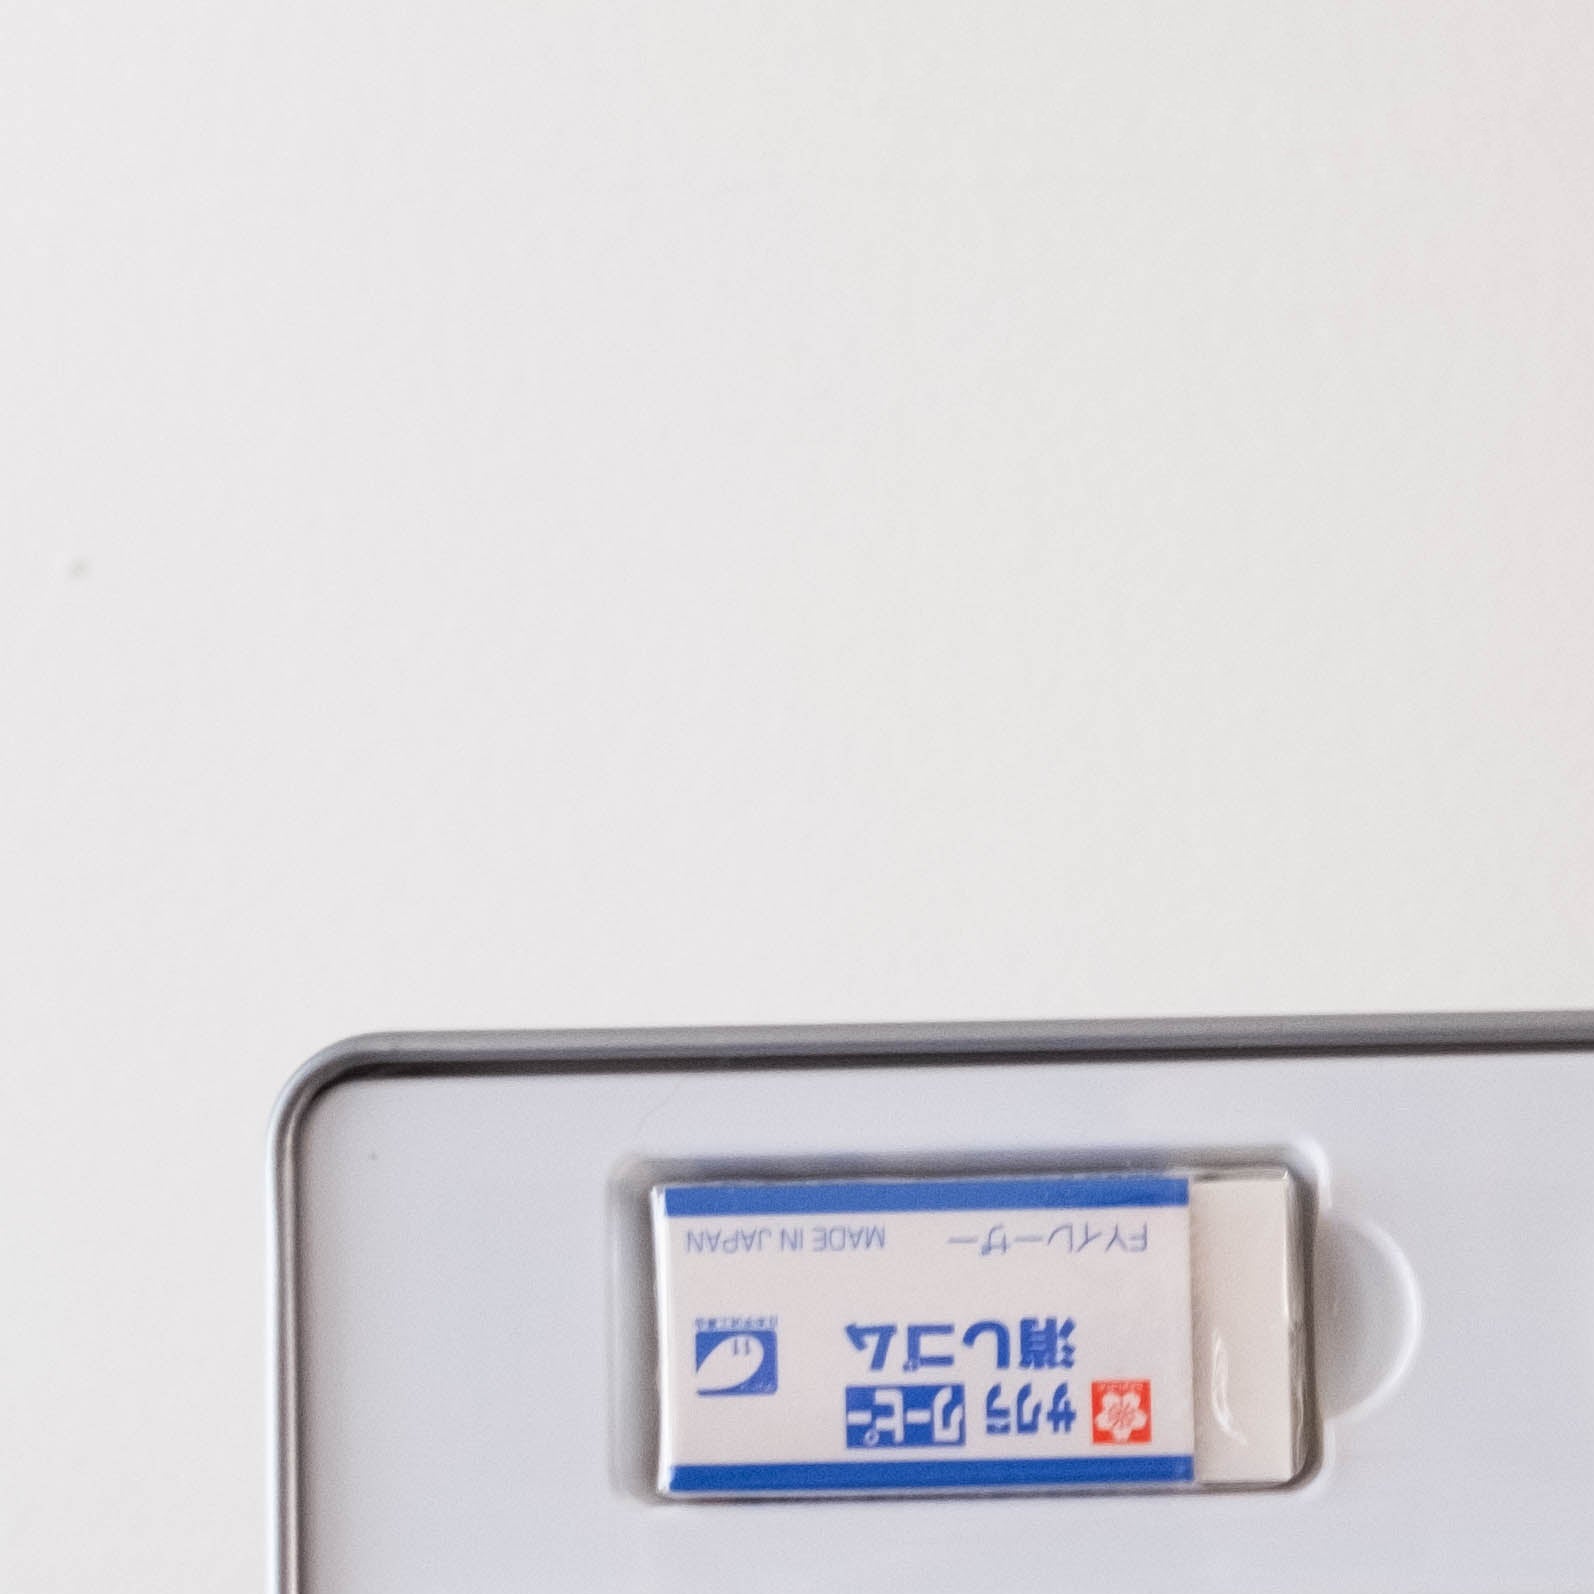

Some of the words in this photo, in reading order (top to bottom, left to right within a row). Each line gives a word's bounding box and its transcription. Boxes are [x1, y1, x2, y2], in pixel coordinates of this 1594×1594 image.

[686, 1228, 772, 1253] JAPAN
[780, 1227, 807, 1251] IN
[812, 1223, 886, 1251] MADE
[947, 1222, 1149, 1257] FYイレーザー
[844, 1317, 1077, 1372] 消しゴム
[846, 1385, 966, 1448] クーピー
[985, 1381, 1077, 1436] サクラ
